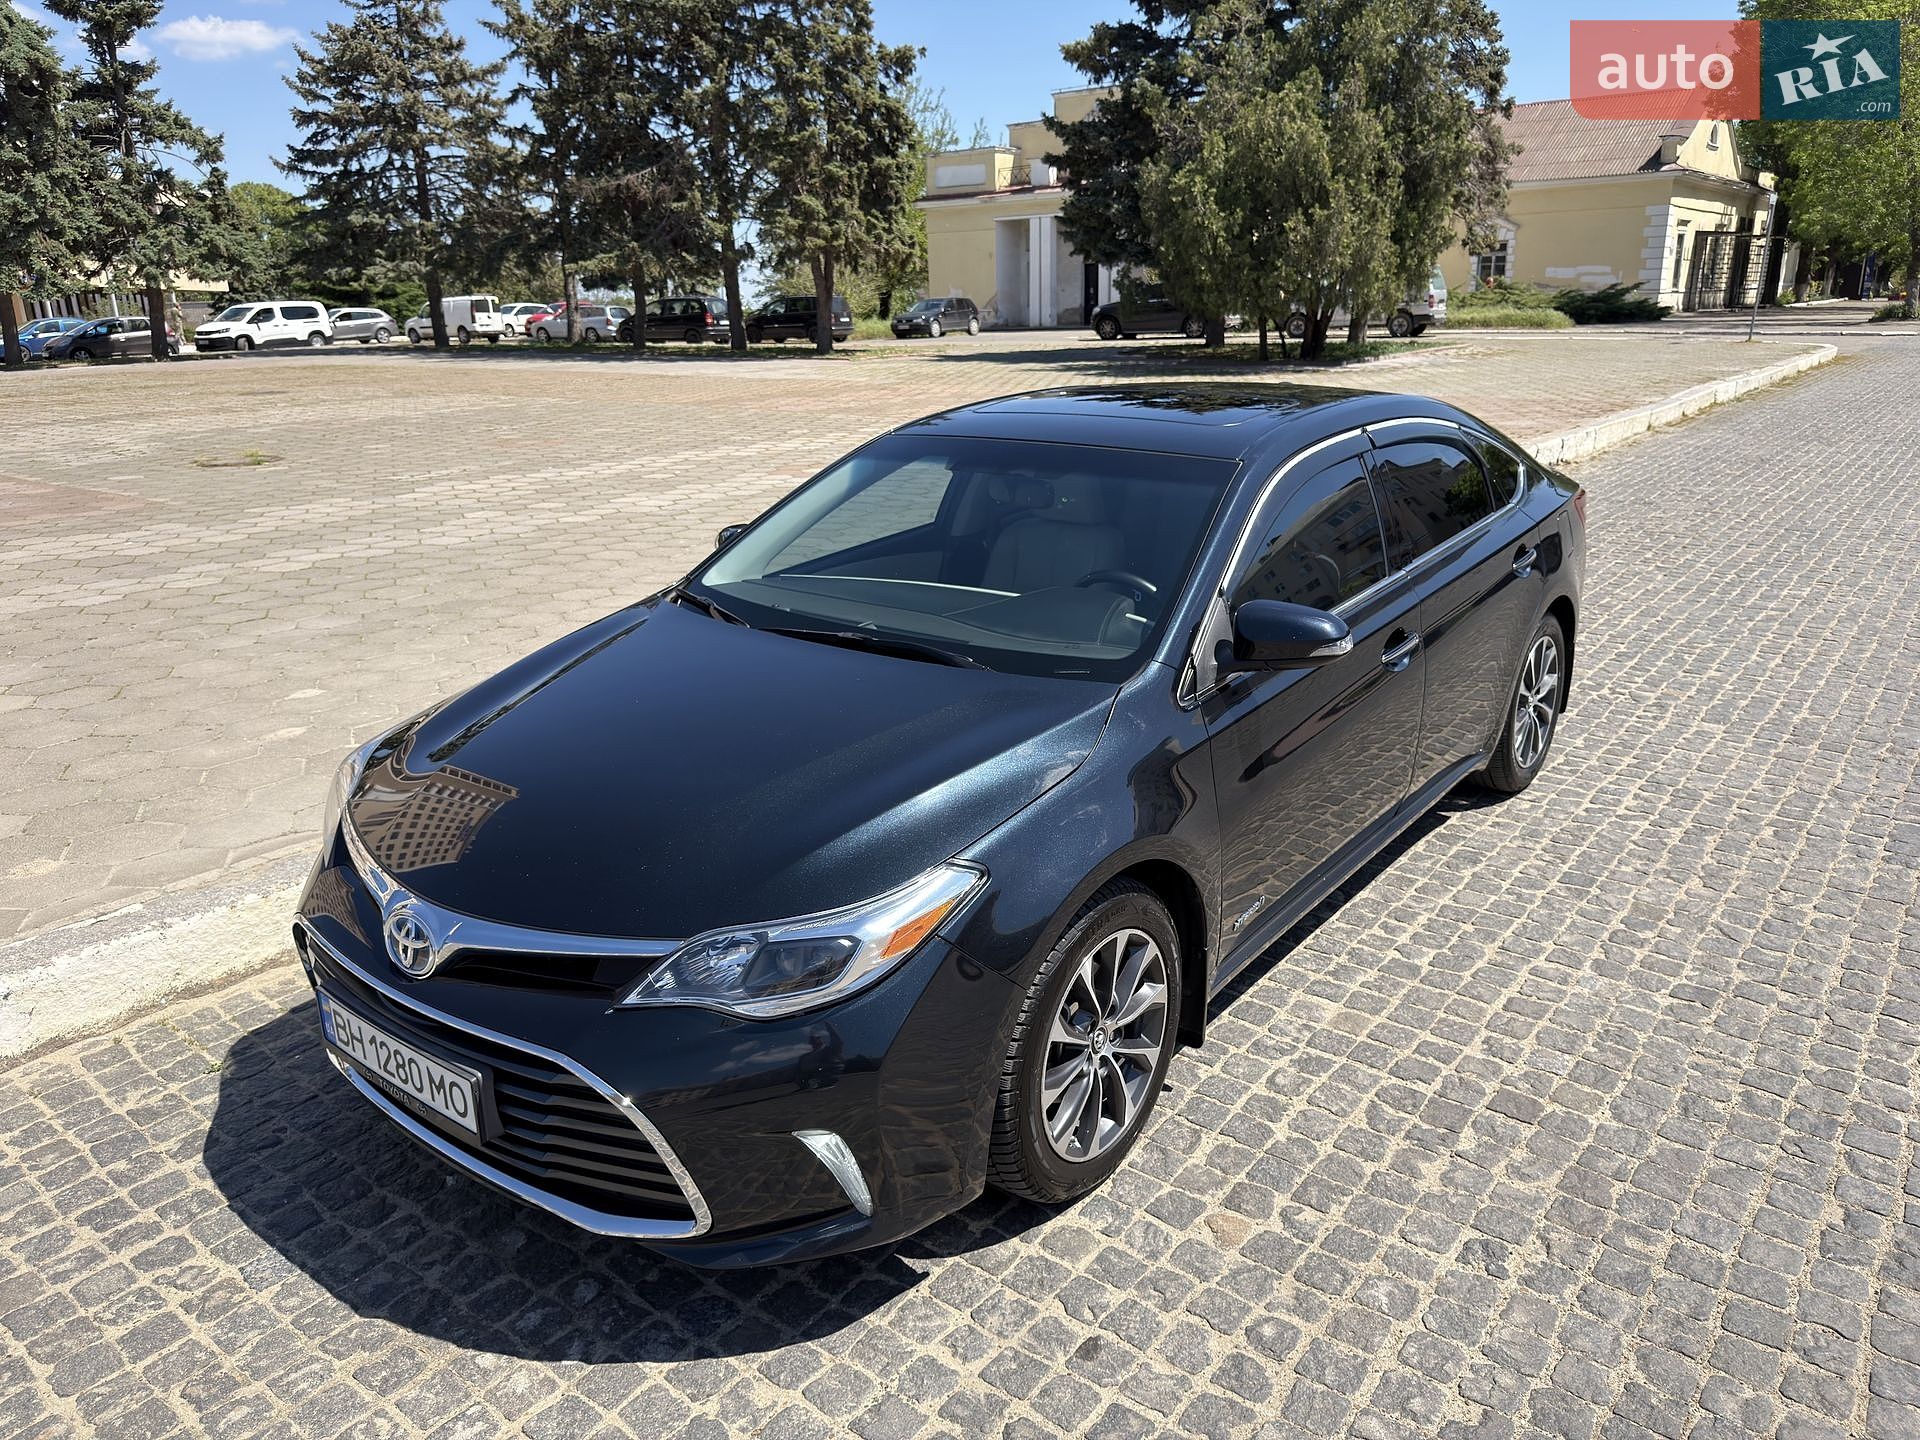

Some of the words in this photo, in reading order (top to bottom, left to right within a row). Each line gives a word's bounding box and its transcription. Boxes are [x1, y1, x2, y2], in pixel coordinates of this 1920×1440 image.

[334, 1009, 367, 1060] BH
[369, 1035, 423, 1094] 1280
[426, 1066, 468, 1118] MO
[379, 1079, 410, 1105] TOYOTA
